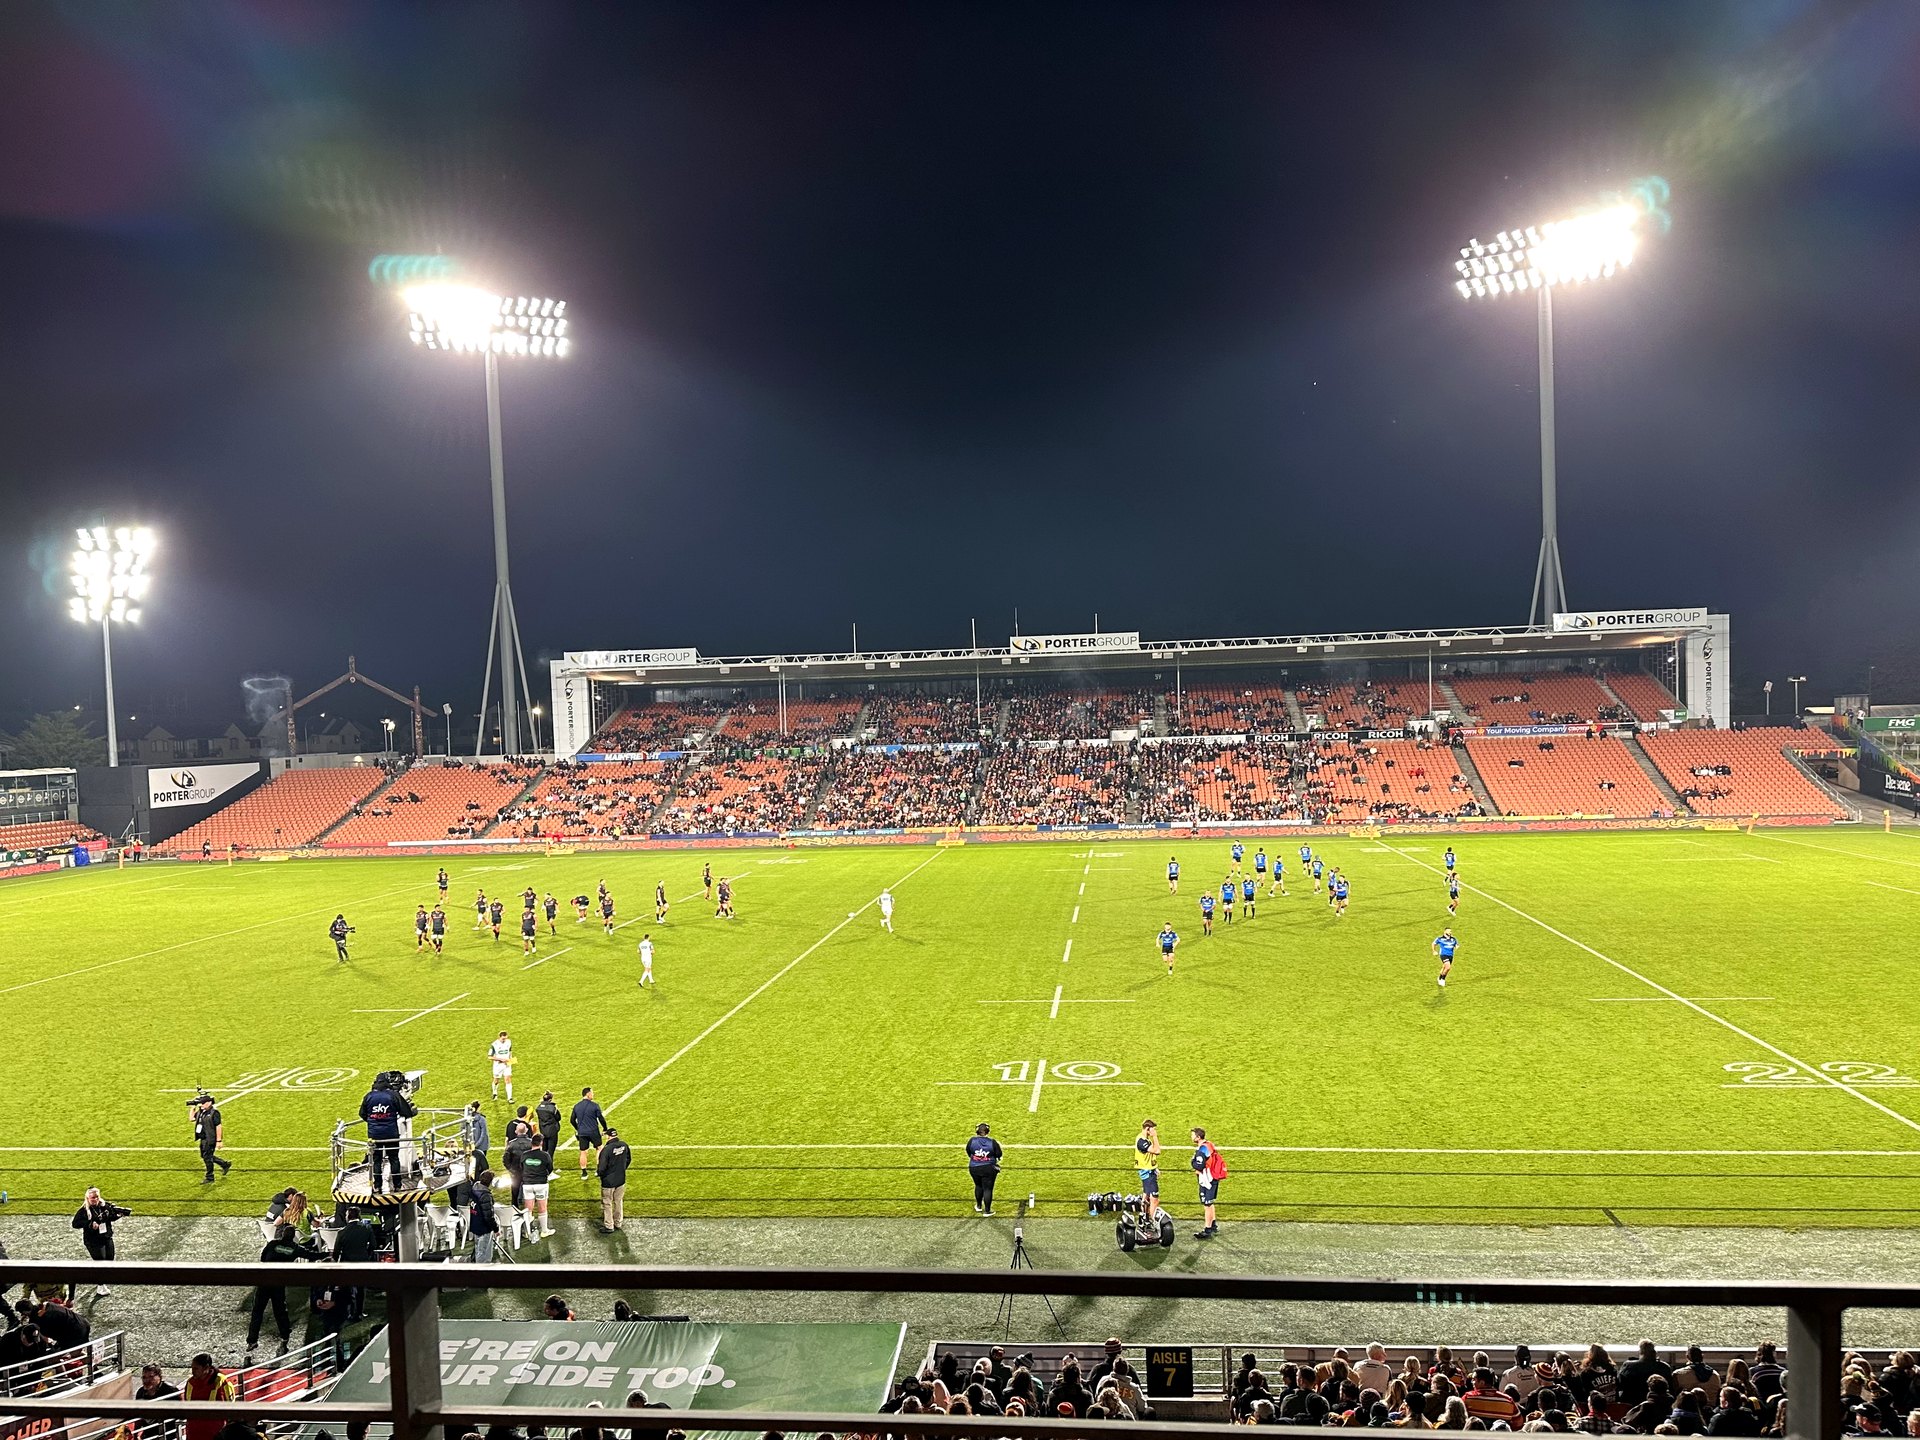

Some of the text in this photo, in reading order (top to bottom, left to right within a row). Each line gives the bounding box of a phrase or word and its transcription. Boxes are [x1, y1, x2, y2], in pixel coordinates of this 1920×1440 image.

[1597, 611, 1701, 626] PORTERGROUP
[1045, 635, 1138, 649] PORTERGROUP
[605, 652, 690, 664] RTERGROUP
[1888, 718, 1916, 727] FMG
[1505, 726, 1531, 735] Moving
[1532, 724, 1567, 735] Company
[1255, 730, 1404, 743] RICOH RICOH RICOH
[604, 751, 661, 761] MAINFREHT
[153, 787, 216, 803] PORTERGROUP
[992, 1060, 1122, 1081] 10
[1722, 1061, 1920, 1084] 22
[226, 1067, 360, 1088] 10
[372, 1103, 390, 1114] sky
[974, 1148, 990, 1158] sky
[384, 1337, 618, 1363] E'RE ON
[1152, 1352, 1188, 1365] AISLE
[368, 1361, 738, 1389] YUR SIDE TOO.
[1162, 1367, 1177, 1388] 7
[1591, 1375, 1617, 1387] CHIEFS
